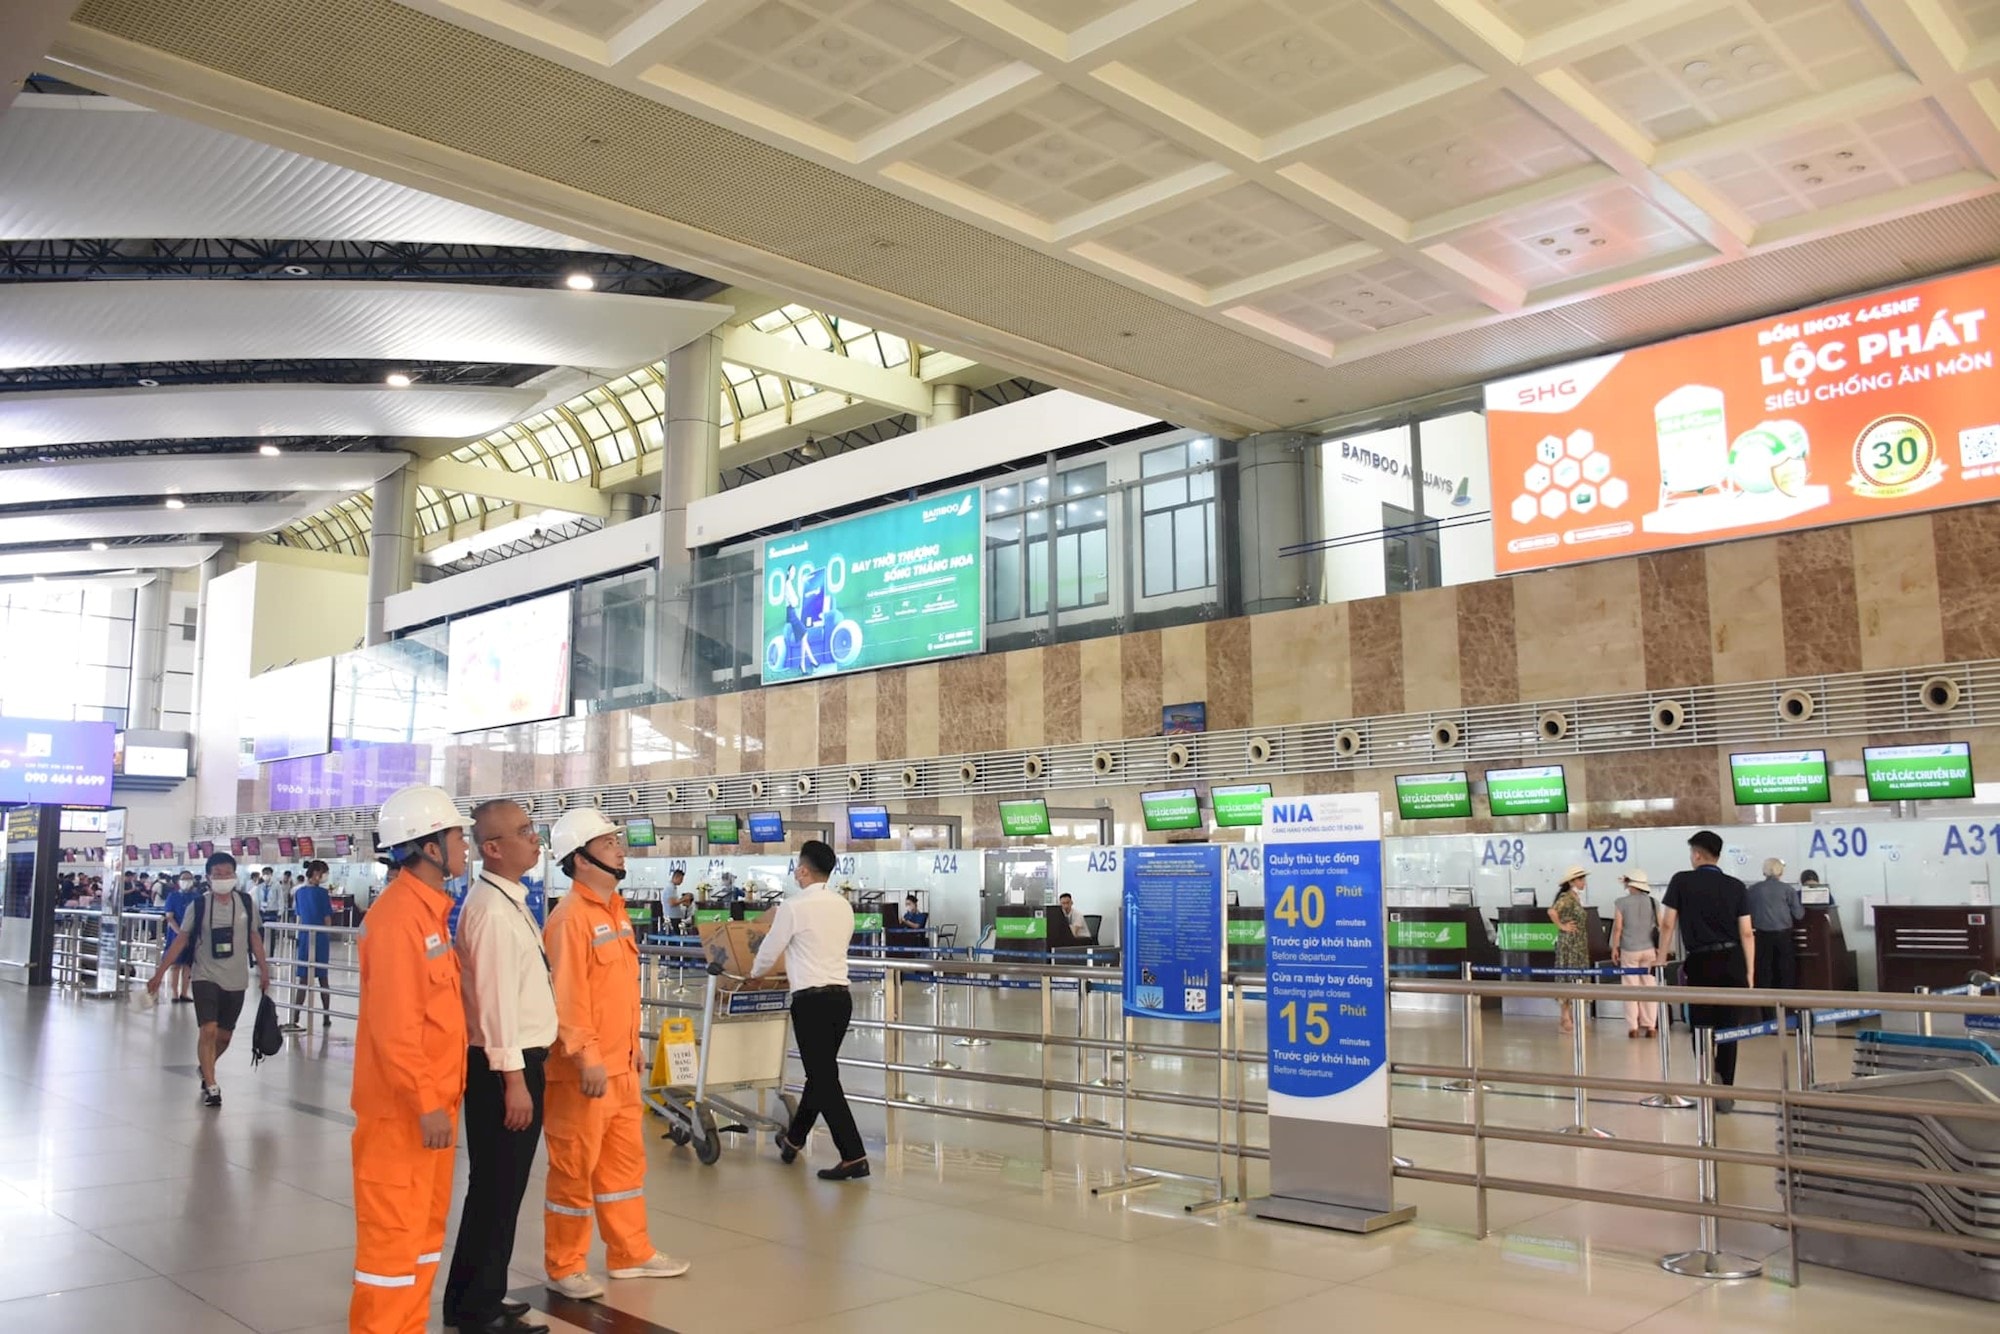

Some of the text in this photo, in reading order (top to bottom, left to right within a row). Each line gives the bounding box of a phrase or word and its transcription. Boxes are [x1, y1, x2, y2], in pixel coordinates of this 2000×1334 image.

[1803, 312, 1852, 335] INOX
[1760, 309, 1985, 385] LỘC PHÁT
[1765, 352, 1993, 411] SIÊU CHỐNG ĂN MÒN
[1518, 379, 1576, 405] SHG
[1342, 441, 1398, 475] BAMBOO
[1872, 437, 1918, 469] 30
[24, 772, 105, 786] 090 464 6699
[1808, 774, 1823, 784] BAY
[1872, 770, 1886, 782] TẤT
[1898, 768, 1914, 780] CÁC
[1950, 768, 1966, 778] BAY
[1272, 804, 1313, 823] NIA
[1809, 826, 1868, 858] A30
[1088, 850, 1117, 872] A25
[1228, 847, 1260, 870] A26
[1296, 853, 1312, 864] thủ
[1315, 854, 1330, 866] tục
[1334, 852, 1360, 866] đóng
[1482, 838, 1525, 866] A28
[834, 857, 854, 875] A23
[933, 854, 958, 874] A24
[1336, 884, 1362, 897] Phút
[1274, 884, 1325, 928] 40
[1336, 918, 1366, 926] minutes
[1271, 936, 1372, 949] Trước giờ khởi hành
[1272, 951, 1336, 962] Before departure
[1272, 972, 1291, 982] Cửa
[1305, 974, 1325, 986] máy
[1328, 974, 1345, 986] bay
[1348, 974, 1372, 988] đóng
[1274, 986, 1351, 998] Boarding gate closes
[1340, 1004, 1367, 1016] Phút
[1280, 1001, 1330, 1045] 15
[1340, 1037, 1370, 1046] minutes
[1273, 1049, 1370, 1066] Trước giờ khởi hành
[1274, 1066, 1334, 1078] Before departure
